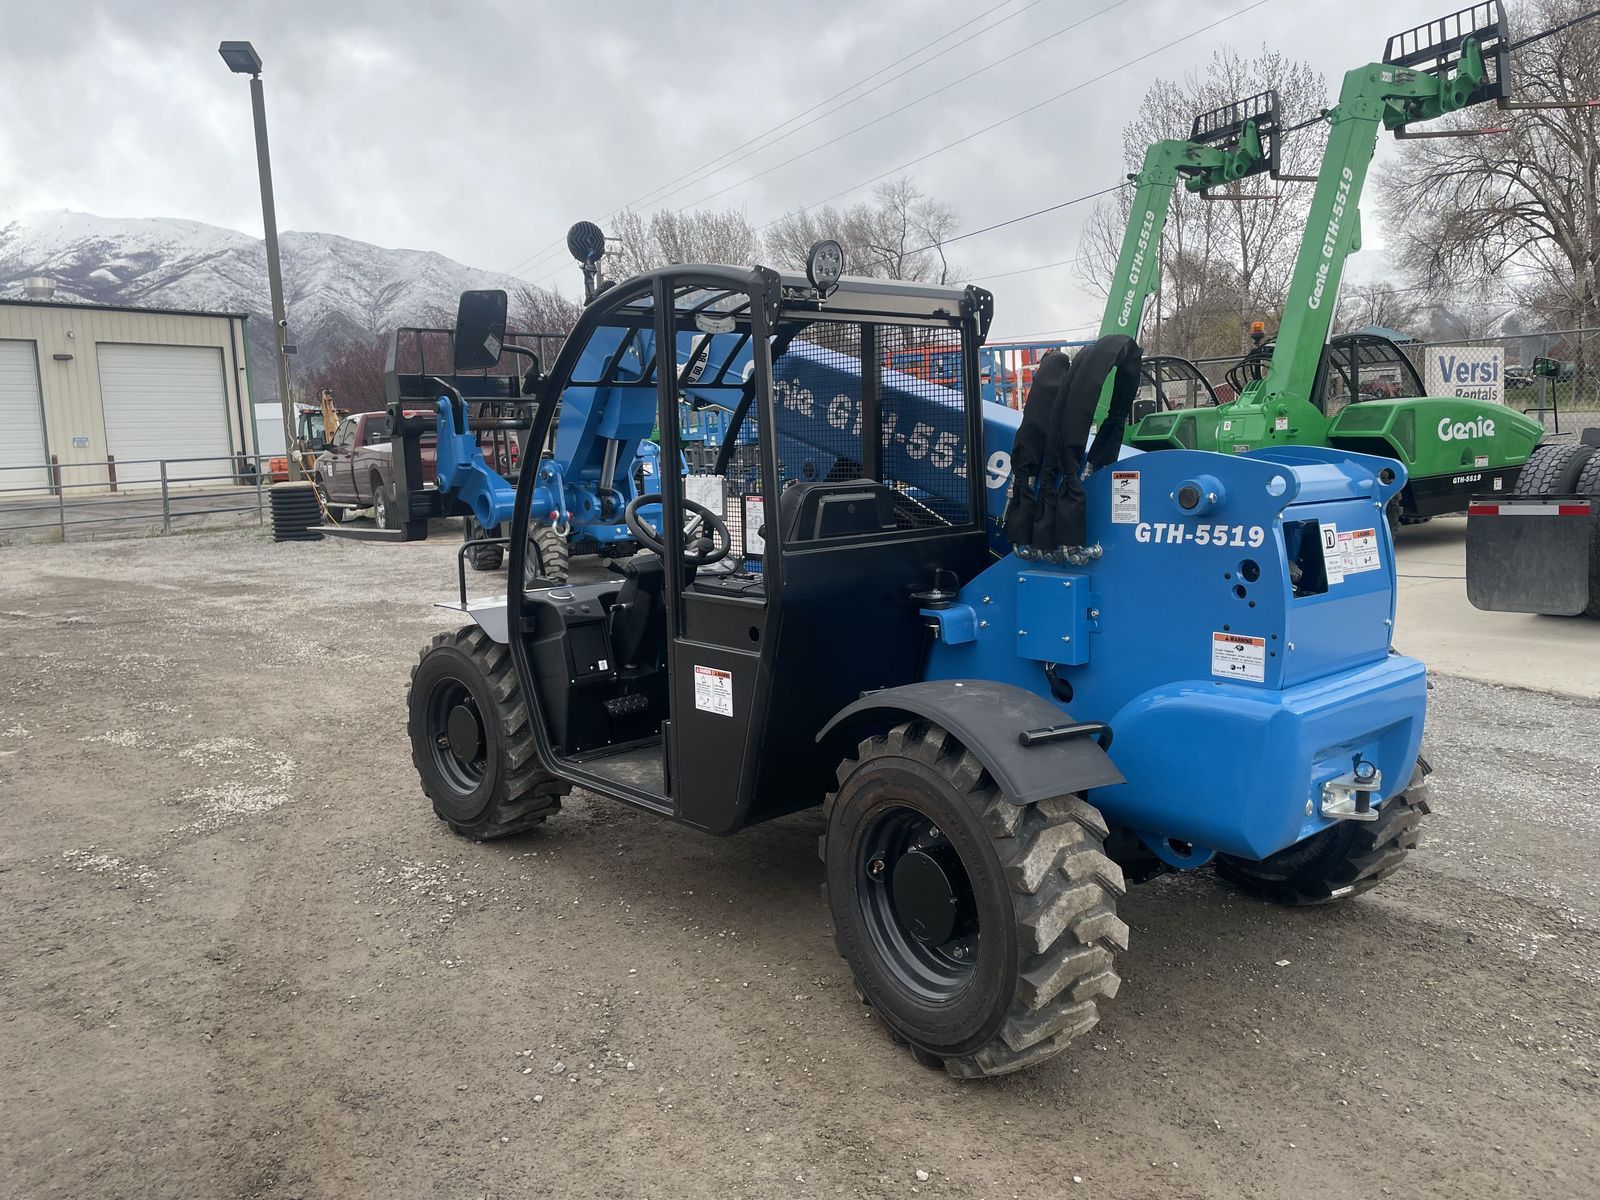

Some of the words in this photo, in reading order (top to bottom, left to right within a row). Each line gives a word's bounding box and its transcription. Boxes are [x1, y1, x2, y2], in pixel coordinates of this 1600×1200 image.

[1308, 262, 1330, 310] Genie
[1322, 166, 1353, 258] GTH-5519
[1118, 289, 1135, 327] Genie
[1129, 210, 1155, 285] GTH-5519
[1439, 355, 1498, 383] Versi
[1456, 387, 1498, 400] Rentals
[1438, 415, 1495, 441] Genie
[1452, 474, 1481, 484] GTH-5519
[1135, 522, 1265, 548] GTH-5519
[1230, 635, 1253, 644] WARNING
